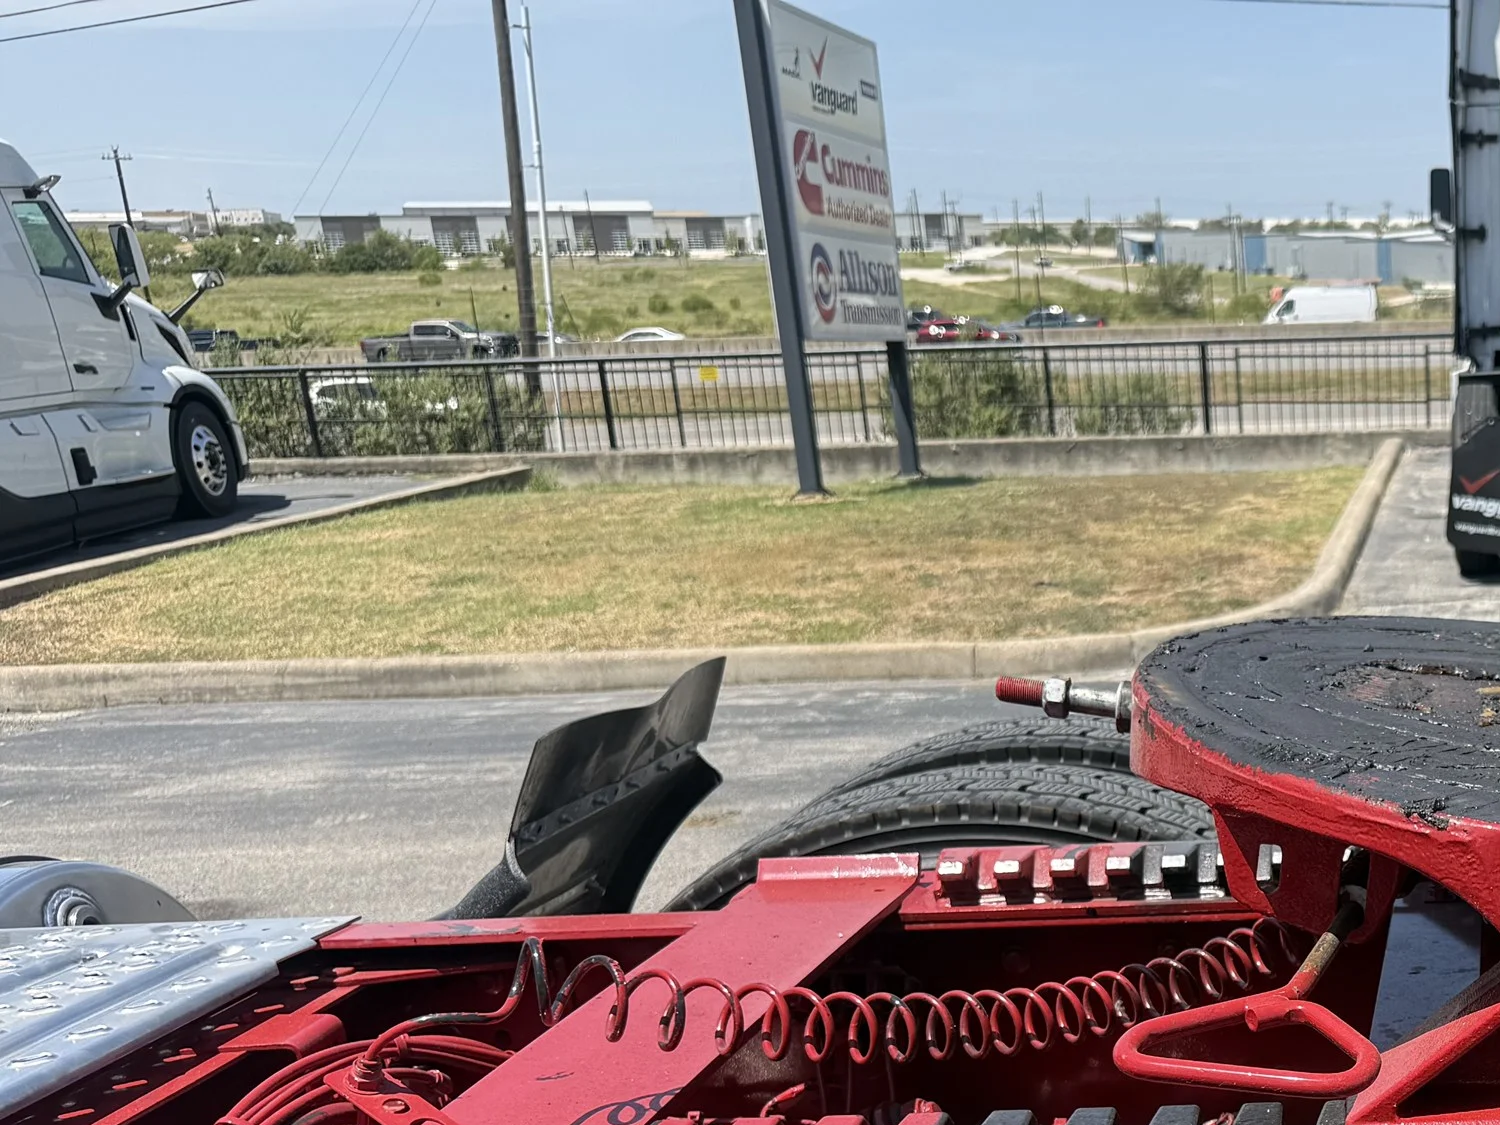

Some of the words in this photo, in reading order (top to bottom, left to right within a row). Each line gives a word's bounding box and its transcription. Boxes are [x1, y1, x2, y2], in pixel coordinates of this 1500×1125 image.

[810, 81, 858, 115] vanguard
[821, 144, 889, 197] Cummins
[826, 195, 869, 224] Authorized
[839, 248, 898, 296] Allison
[840, 300, 901, 325] Transmission
